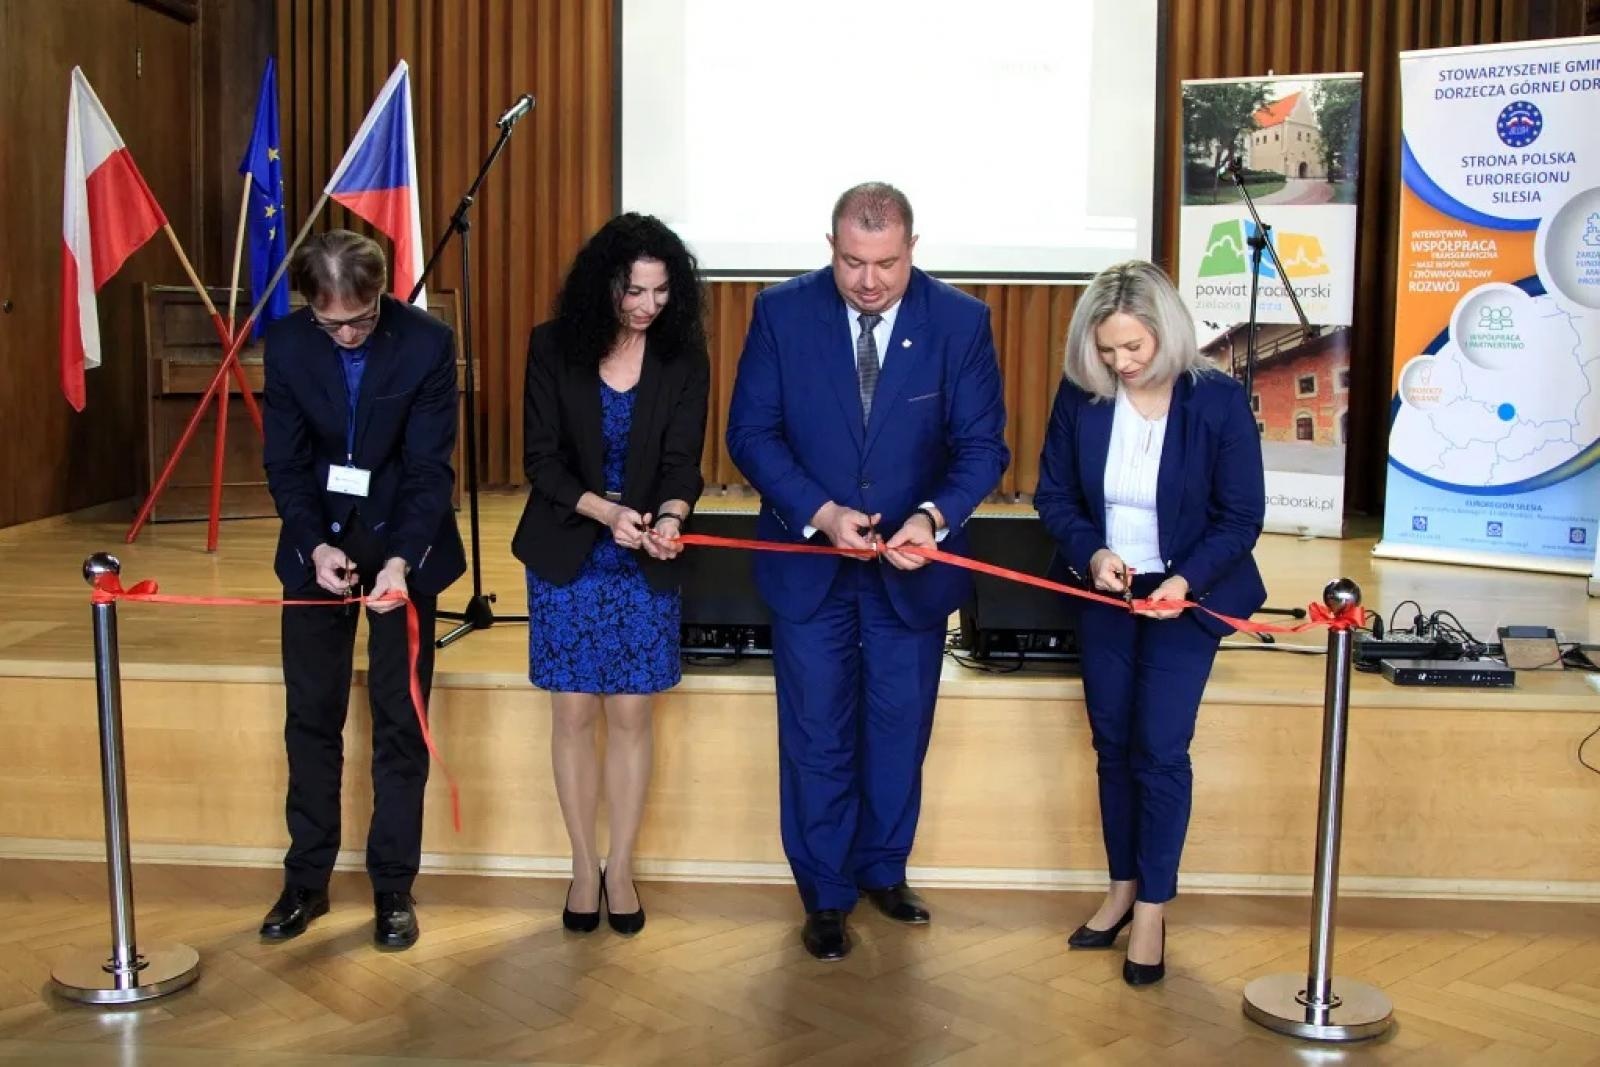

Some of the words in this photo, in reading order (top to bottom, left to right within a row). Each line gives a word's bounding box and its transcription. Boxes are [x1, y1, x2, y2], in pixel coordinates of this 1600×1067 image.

[1438, 61, 1561, 82] STOWARZYSZENIE
[1435, 85, 1506, 100] DORZECZA
[1510, 80, 1565, 95] GÓRNEJ
[1461, 154, 1518, 168] STRONA
[1521, 152, 1576, 165] POLSKA
[1466, 171, 1570, 186] EUROREGIONU
[1491, 190, 1542, 204] SILESIA
[1411, 230, 1468, 239] INTENSYWNA
[1410, 239, 1497, 252] WSPÓŁPRACA
[1196, 281, 1247, 299] powiat
[1408, 279, 1460, 292] ROZWÓJ
